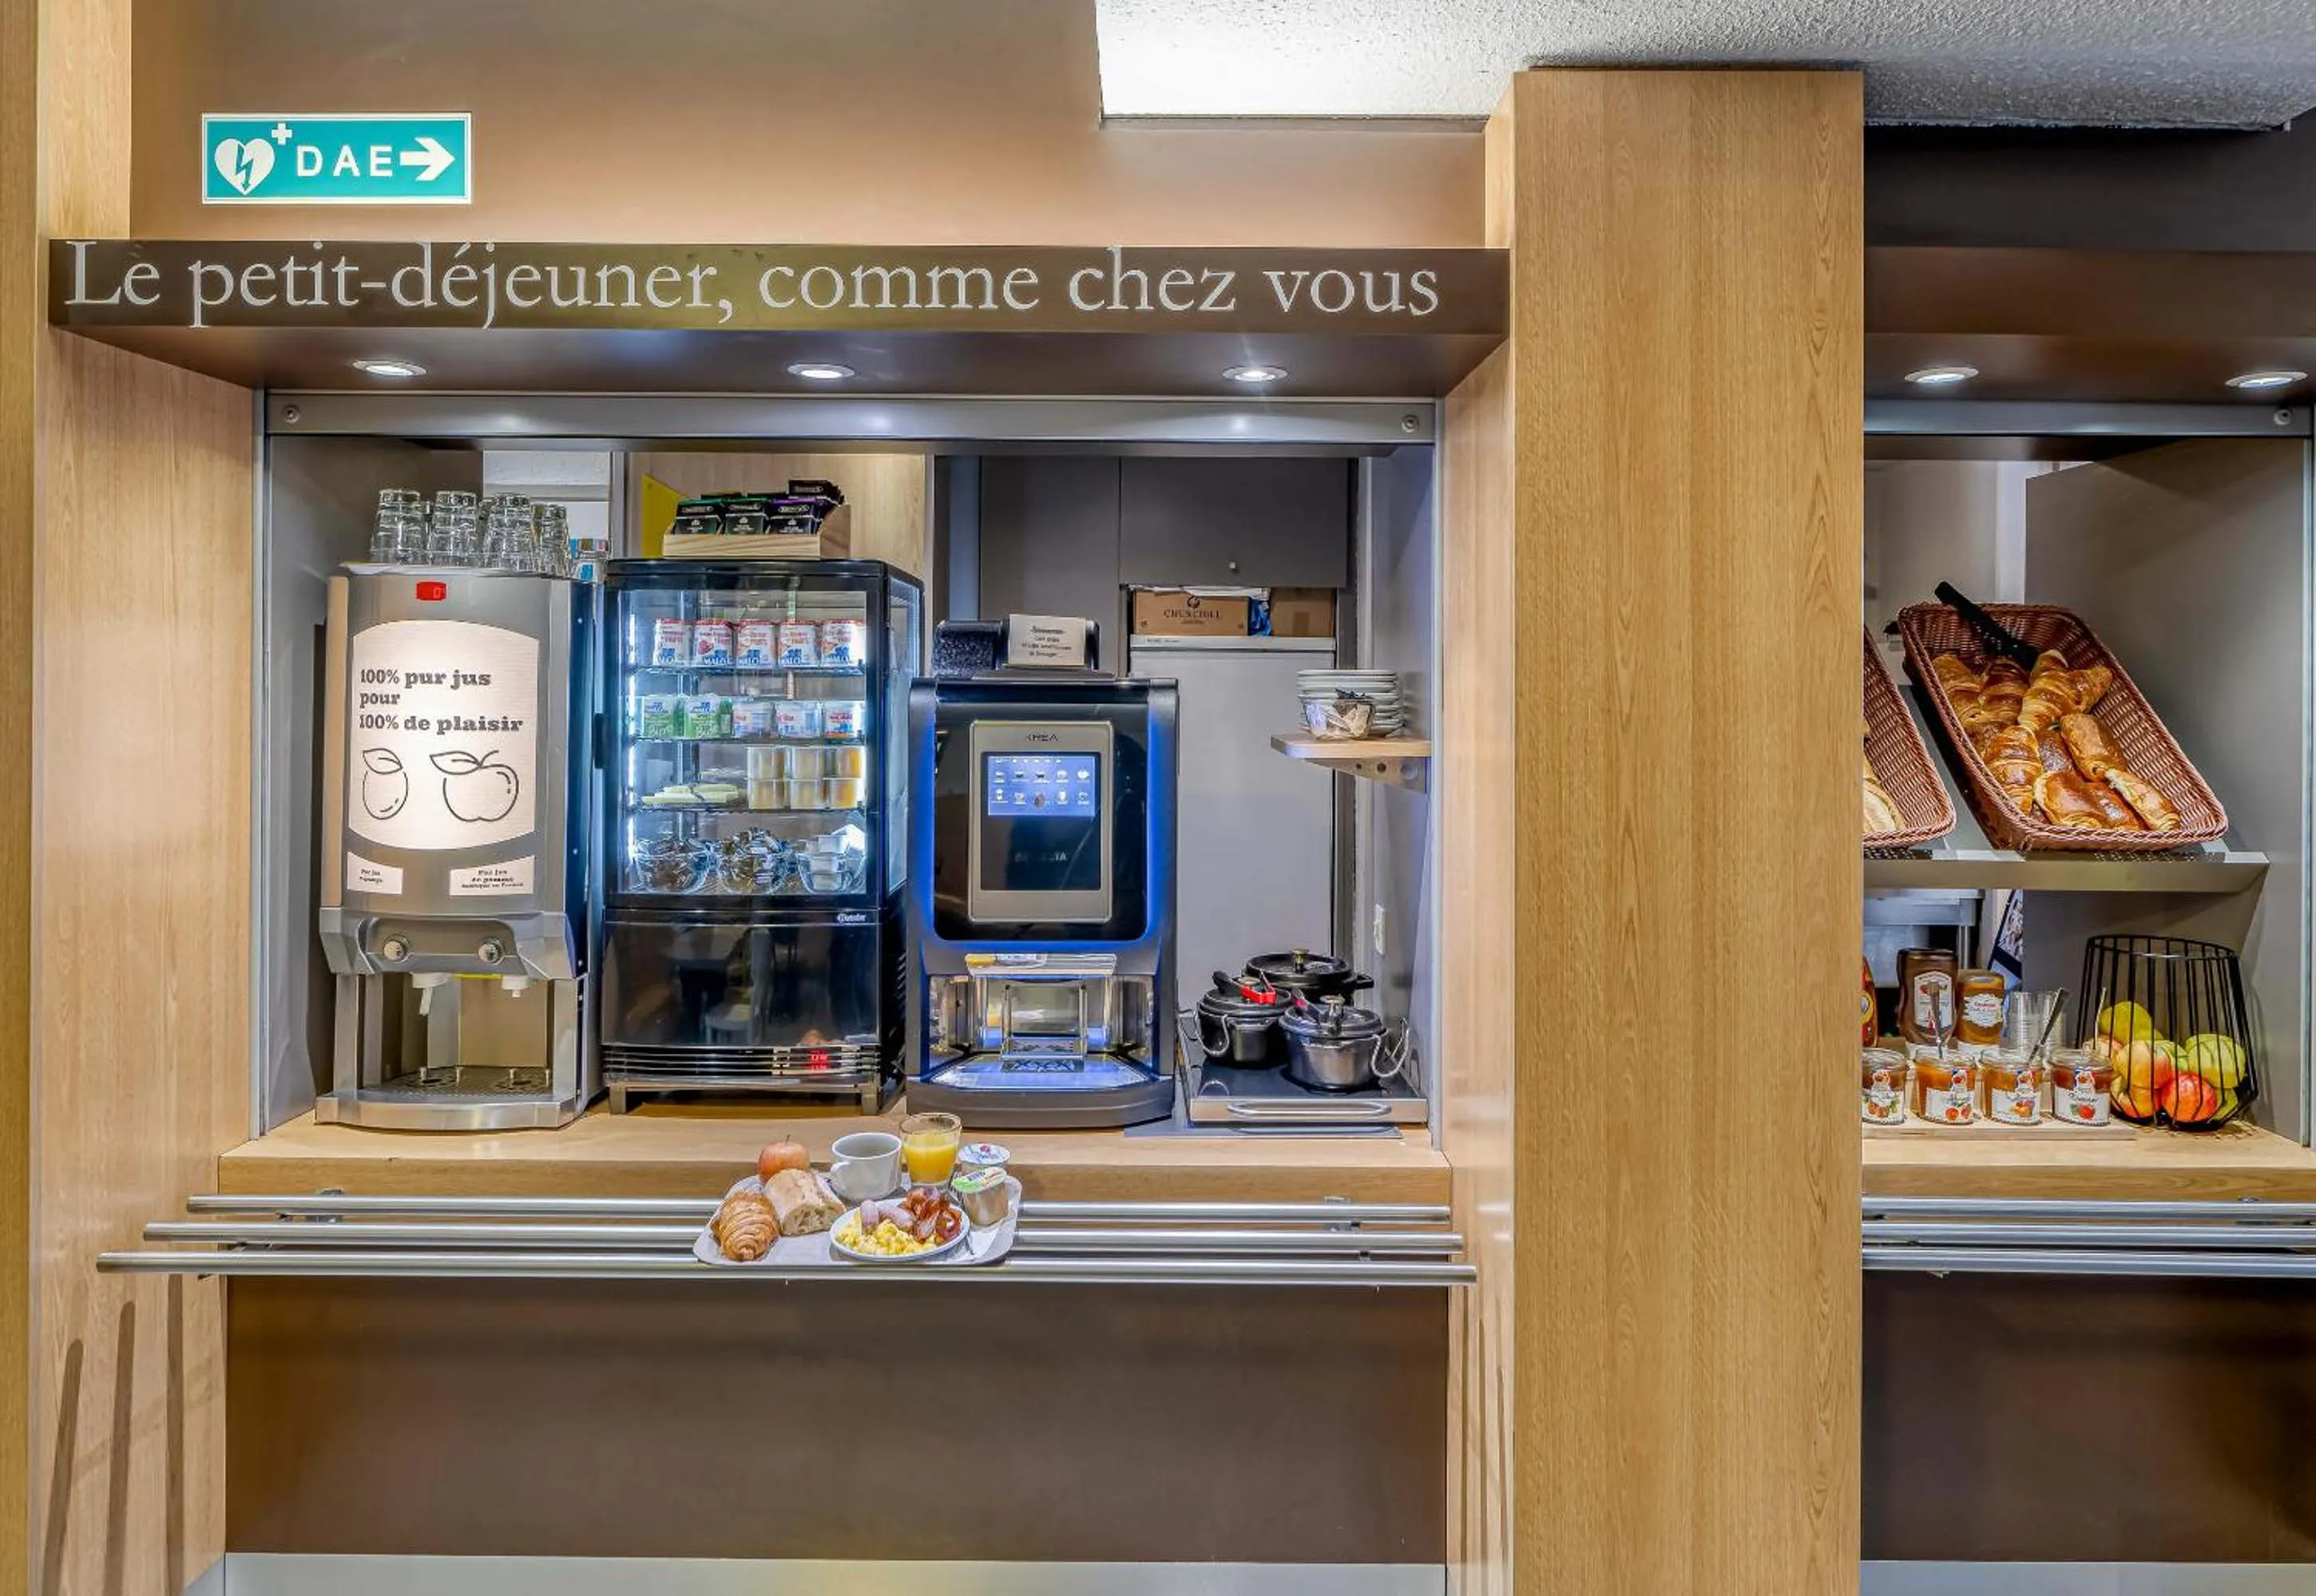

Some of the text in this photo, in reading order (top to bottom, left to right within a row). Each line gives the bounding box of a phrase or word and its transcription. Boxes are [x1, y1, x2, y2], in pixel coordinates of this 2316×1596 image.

[296, 145, 393, 176] DAE
[64, 241, 1438, 329] Le petit-déjeuner, comme chez vous
[360, 669, 491, 690] 100% pur jus
[359, 691, 400, 709] pour
[359, 714, 524, 735] 100% de plaisir
